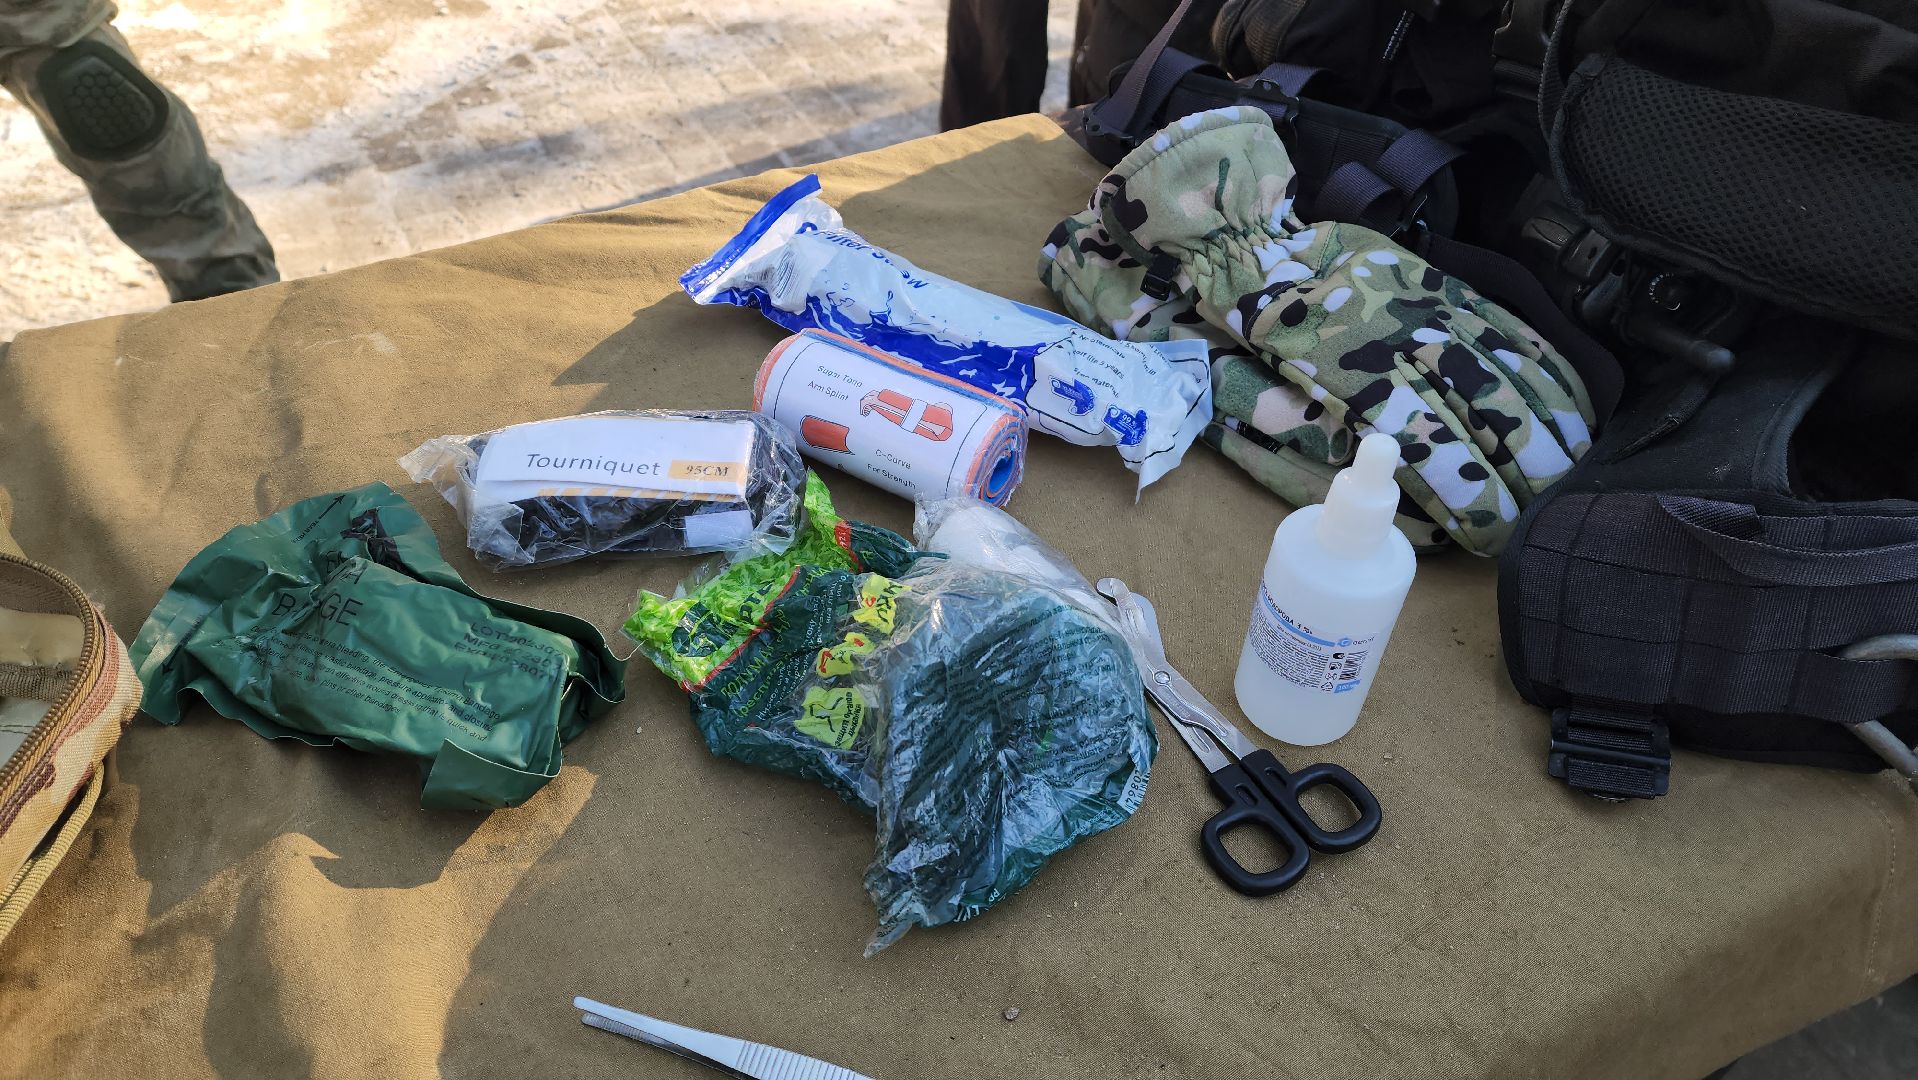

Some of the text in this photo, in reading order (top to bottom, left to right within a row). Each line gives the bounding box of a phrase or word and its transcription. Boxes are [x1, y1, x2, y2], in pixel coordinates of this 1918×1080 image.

[807, 381, 849, 401] Arm Splint
[526, 453, 729, 478] Tourniquet 95CM
[462, 696, 500, 720] Bandage
